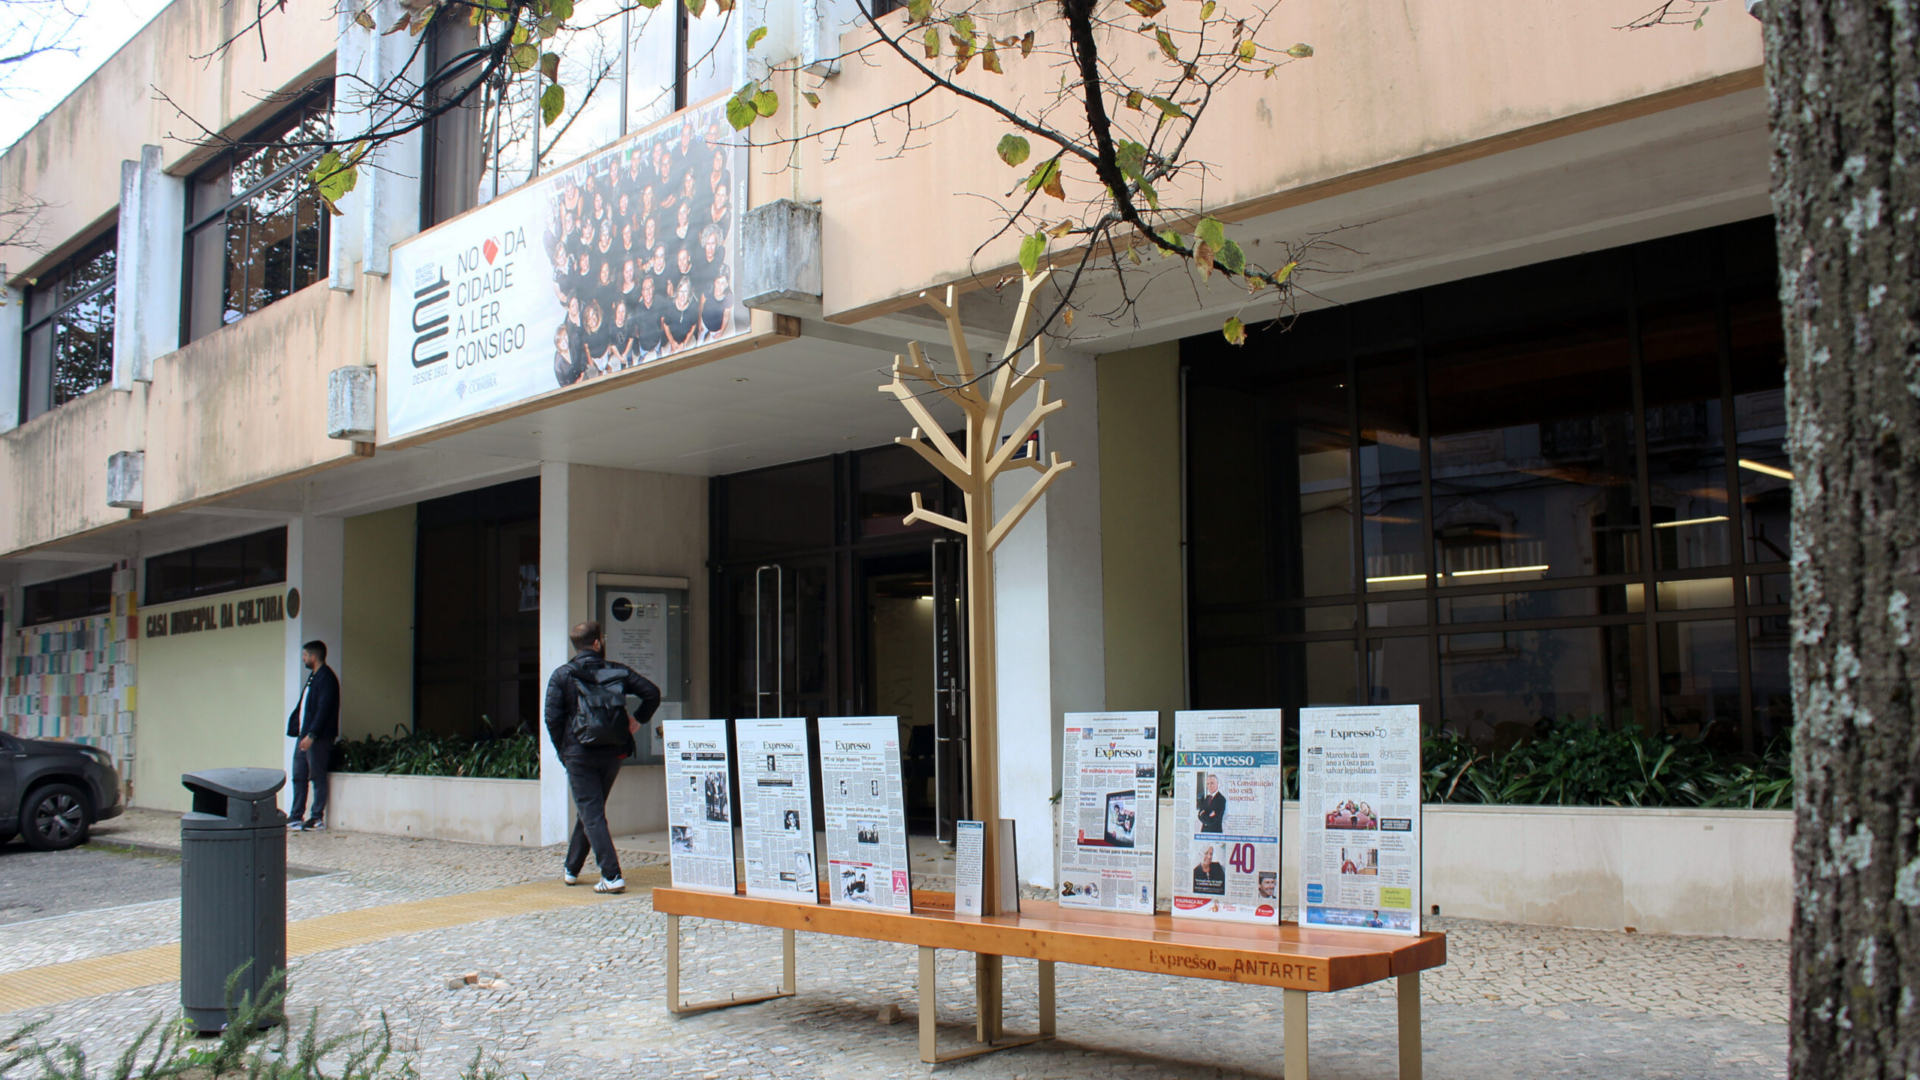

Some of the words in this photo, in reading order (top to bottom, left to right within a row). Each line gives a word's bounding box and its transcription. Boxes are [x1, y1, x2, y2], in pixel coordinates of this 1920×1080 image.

[457, 246, 479, 276] NO
[504, 226, 526, 257] DA
[456, 262, 514, 307] CIDADE
[456, 314, 467, 339] A
[471, 300, 500, 333] LER
[455, 323, 526, 370] CONSIGO
[412, 369, 433, 386] DESDE
[434, 364, 449, 381] 1922
[468, 377, 498, 394] COIMBRA
[146, 613, 168, 638] CASA
[220, 603, 234, 628] DA
[237, 595, 284, 627] CULTURA
[1330, 728, 1375, 740] Expresso
[688, 740, 717, 751] Expresso
[763, 741, 794, 751] Expresso
[835, 740, 871, 752] Expresso
[1095, 747, 1142, 760] Expresso
[1192, 752, 1255, 768] Expresso
[1325, 751, 1350, 759] Marcelo
[1350, 751, 1358, 759] dá
[1344, 766, 1377, 775] legislatura
[1360, 760, 1374, 768] para
[1229, 843, 1255, 874] 40
[1149, 949, 1216, 971] Expresso
[1218, 964, 1231, 973] with
[1233, 958, 1318, 982] ANTARTE
